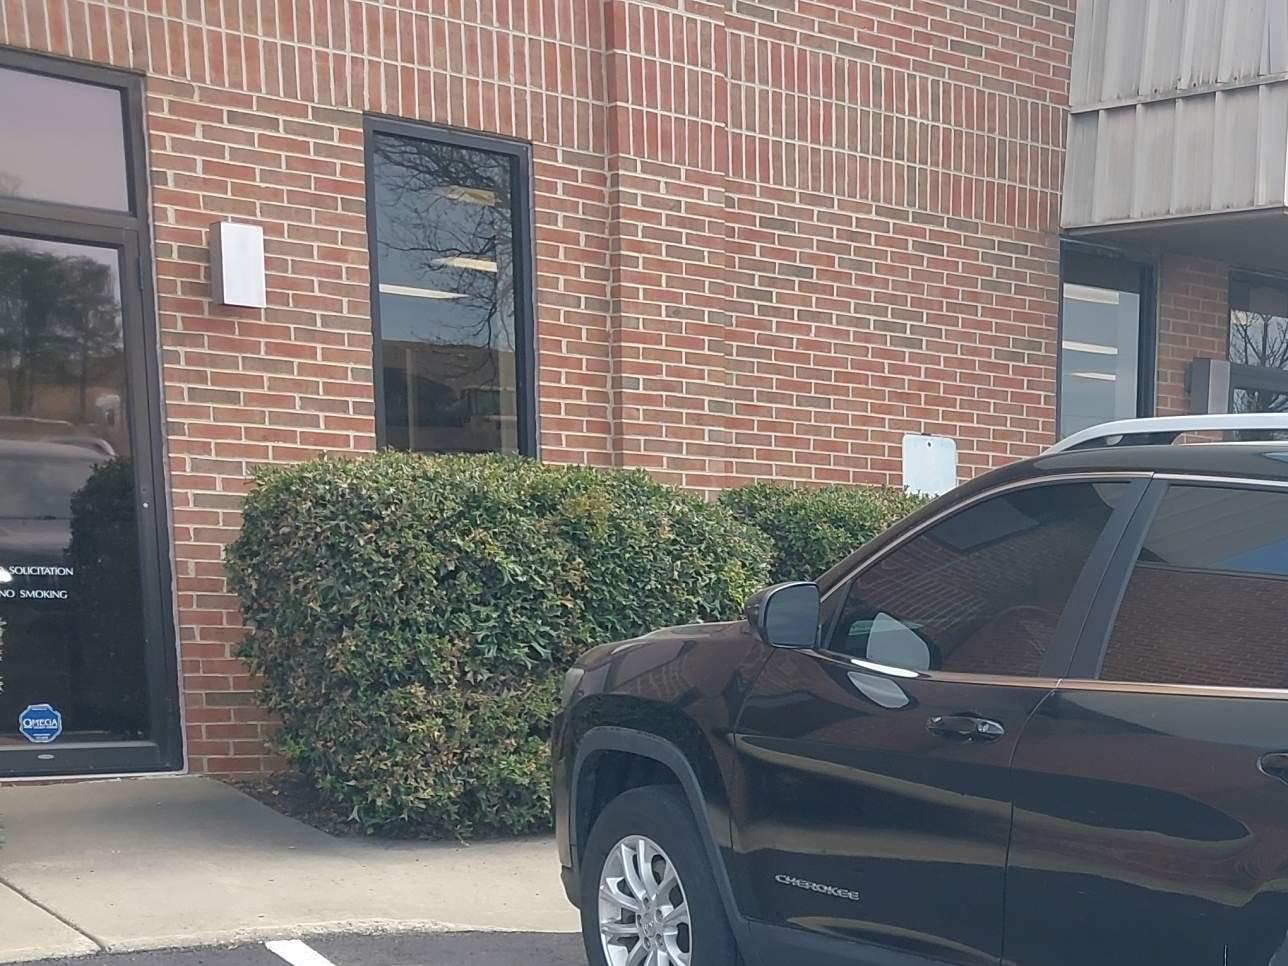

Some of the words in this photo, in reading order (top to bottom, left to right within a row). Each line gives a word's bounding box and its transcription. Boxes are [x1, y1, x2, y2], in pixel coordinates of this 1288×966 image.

[9, 565, 74, 576] SOLICITATION
[0, 589, 15, 598] NO
[19, 589, 68, 599] SMOKING
[775, 874, 860, 901] CHEROKEE
